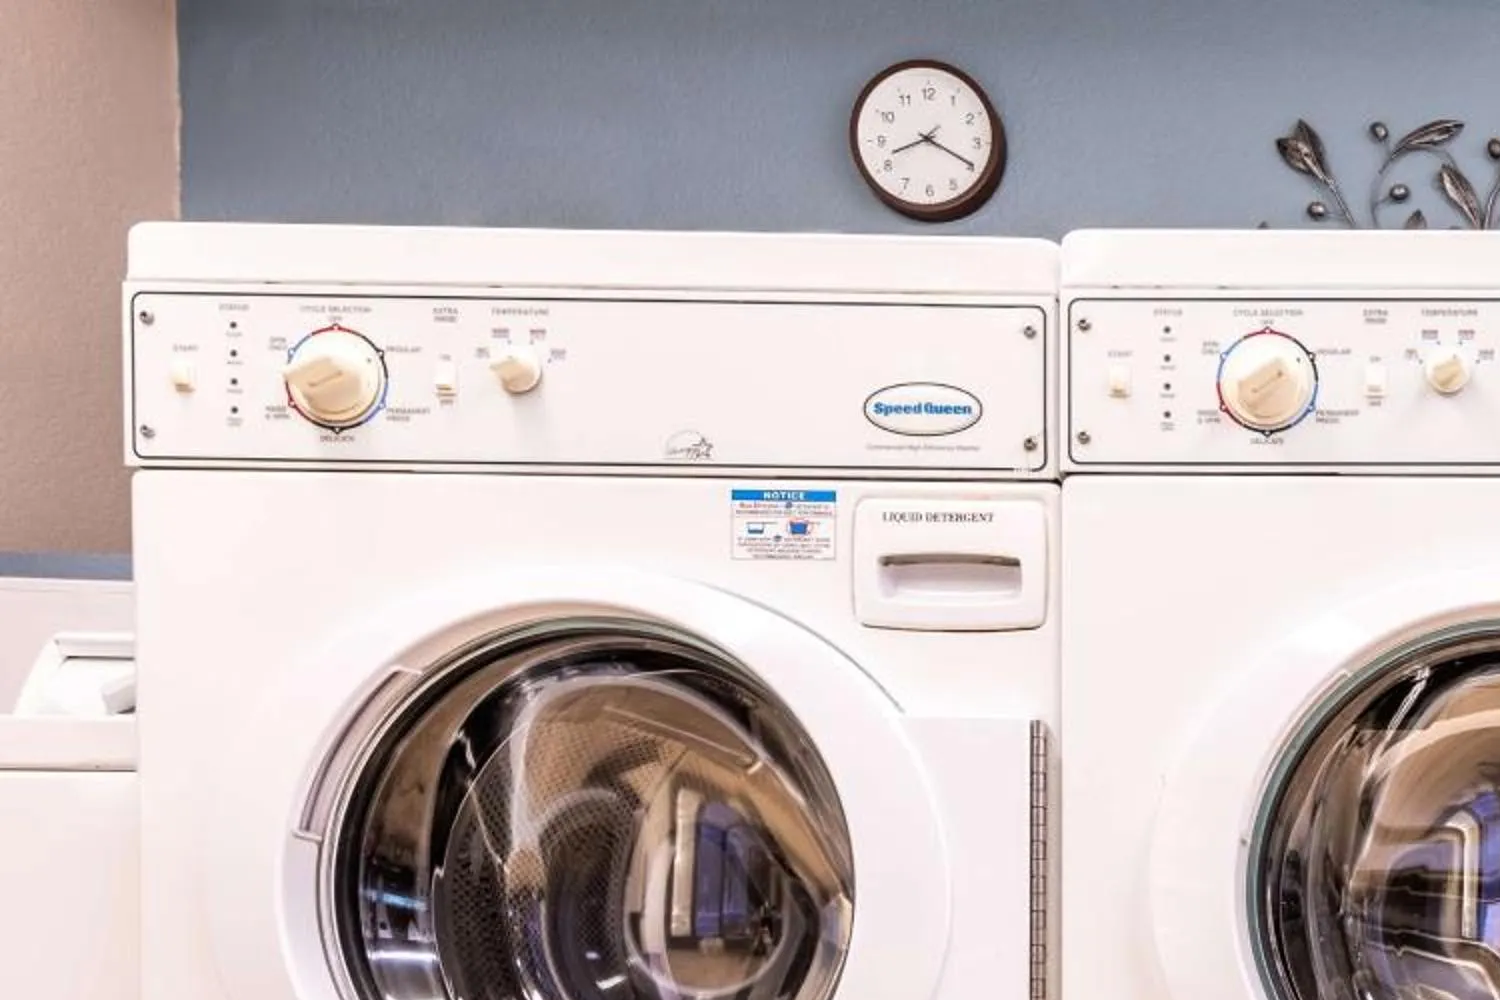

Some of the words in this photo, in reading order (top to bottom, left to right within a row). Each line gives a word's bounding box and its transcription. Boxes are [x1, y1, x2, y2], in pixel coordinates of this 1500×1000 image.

[899, 94, 911, 105] 11
[921, 87, 936, 101] 12
[950, 94, 955, 106] 1
[881, 111, 895, 124] 10
[965, 112, 975, 125] 2
[877, 135, 887, 148] 9
[972, 136, 981, 150] 3
[883, 159, 893, 172] 8
[900, 177, 910, 190] 7
[949, 178, 958, 191] 5
[925, 184, 935, 197] 6
[874, 401, 921, 417] Speed
[924, 402, 973, 415] Queen
[762, 491, 806, 500] NOTICE
[882, 511, 923, 524] LIQUID
[925, 511, 994, 523] DETERGENT
